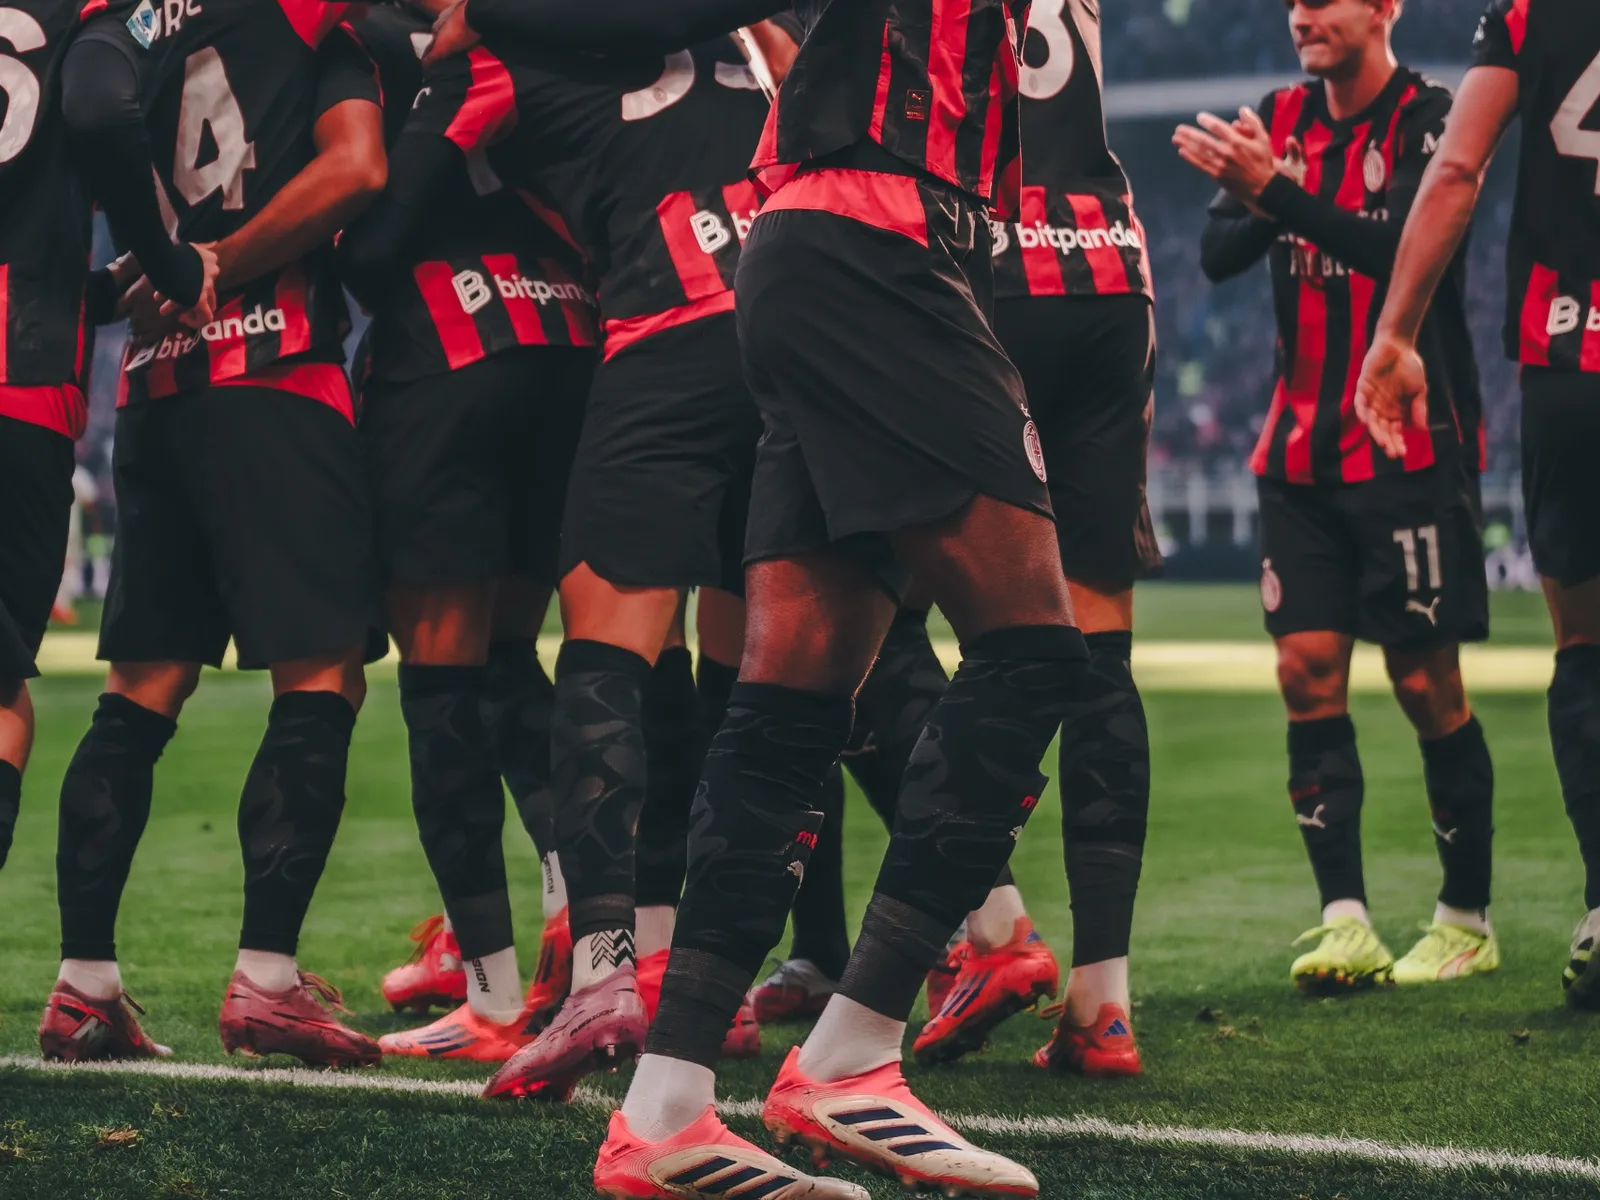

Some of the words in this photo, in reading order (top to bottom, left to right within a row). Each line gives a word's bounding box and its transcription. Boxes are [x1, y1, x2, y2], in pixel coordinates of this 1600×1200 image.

[172, 46, 256, 211] 4
[1014, 220, 1142, 256] bitpanda
[155, 303, 287, 360] bitanda
[1393, 525, 1442, 591] 11
